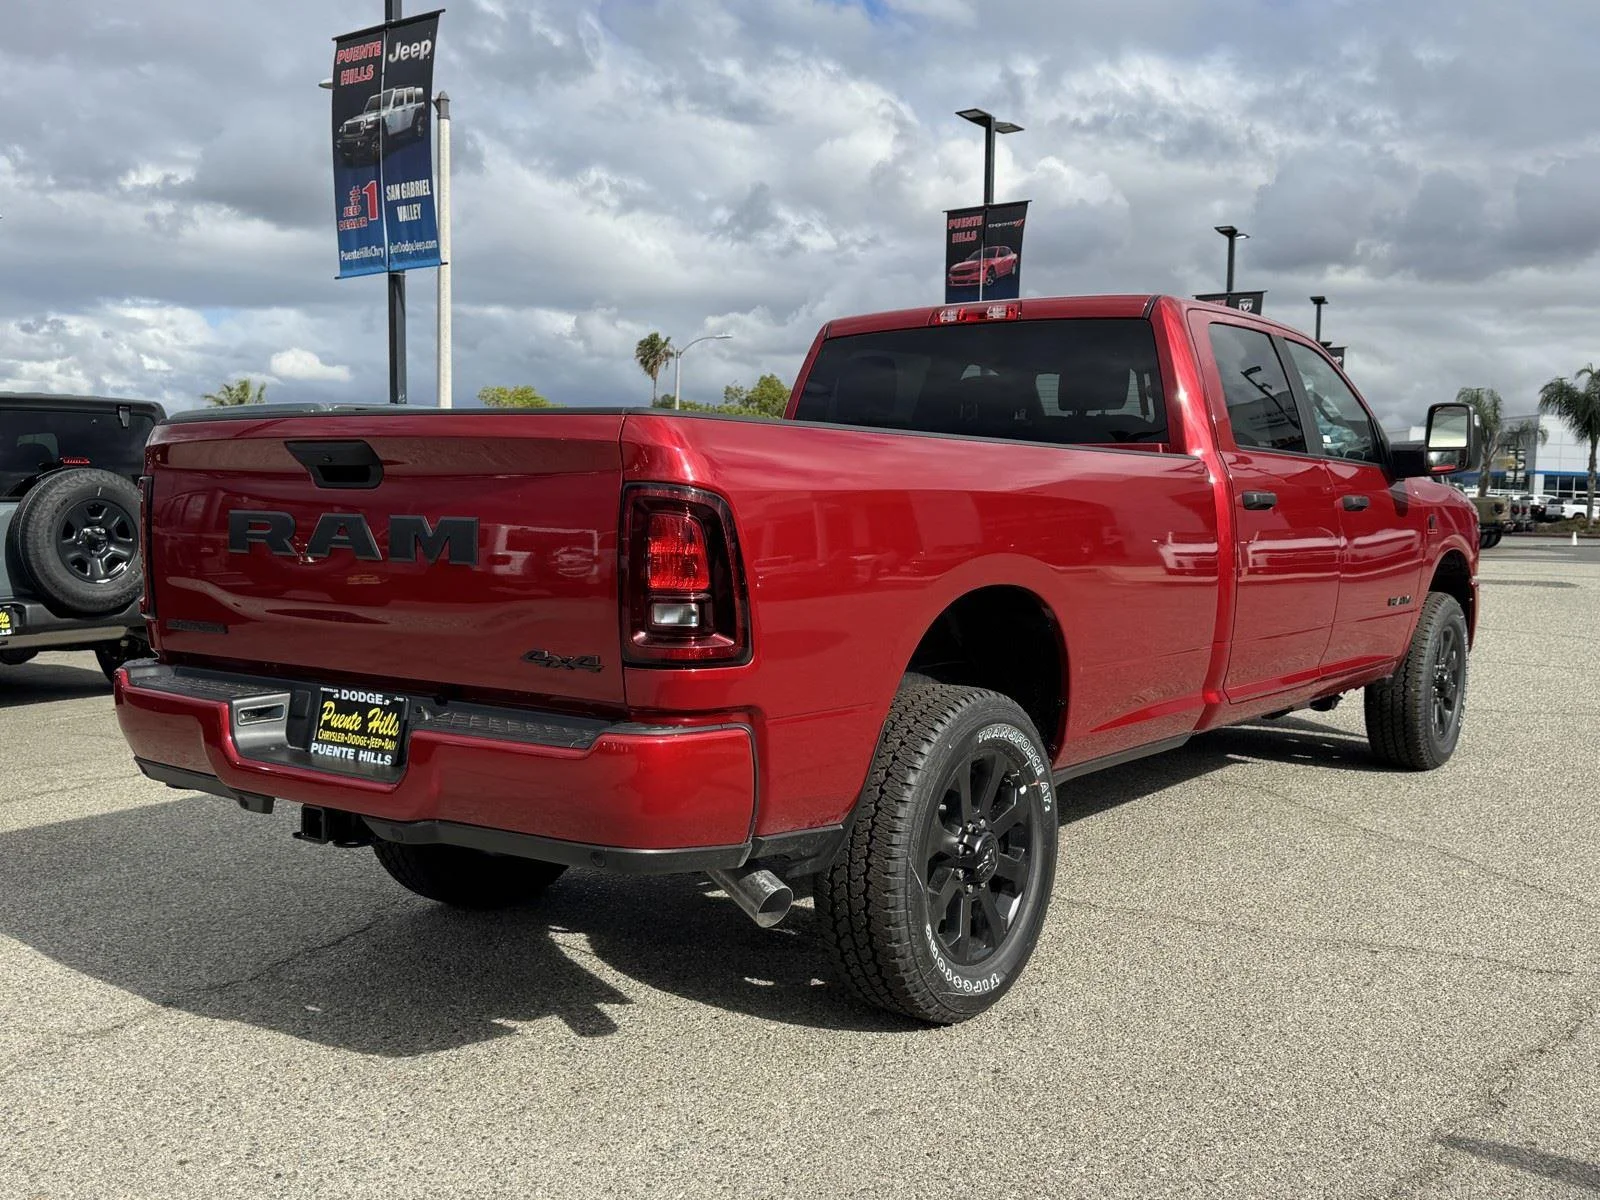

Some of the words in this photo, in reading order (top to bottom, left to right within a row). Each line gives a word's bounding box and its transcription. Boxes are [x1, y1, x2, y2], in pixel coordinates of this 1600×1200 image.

[337, 41, 382, 64] PUENTE
[389, 39, 432, 62] Jeep
[341, 64, 374, 85] HILLS
[386, 184, 400, 201] SAN
[401, 179, 431, 199] GABRIEL
[397, 203, 421, 222] VALLEY
[948, 215, 983, 230] PUENTE
[952, 231, 977, 244] HILLS
[228, 509, 480, 566] RAM
[341, 688, 384, 705] DODGE
[319, 700, 363, 732] Puente
[367, 707, 400, 737] Hills
[310, 742, 355, 760] PUENTE
[358, 750, 393, 766] HILLS
[977, 726, 1045, 777] TRANSFORGE
